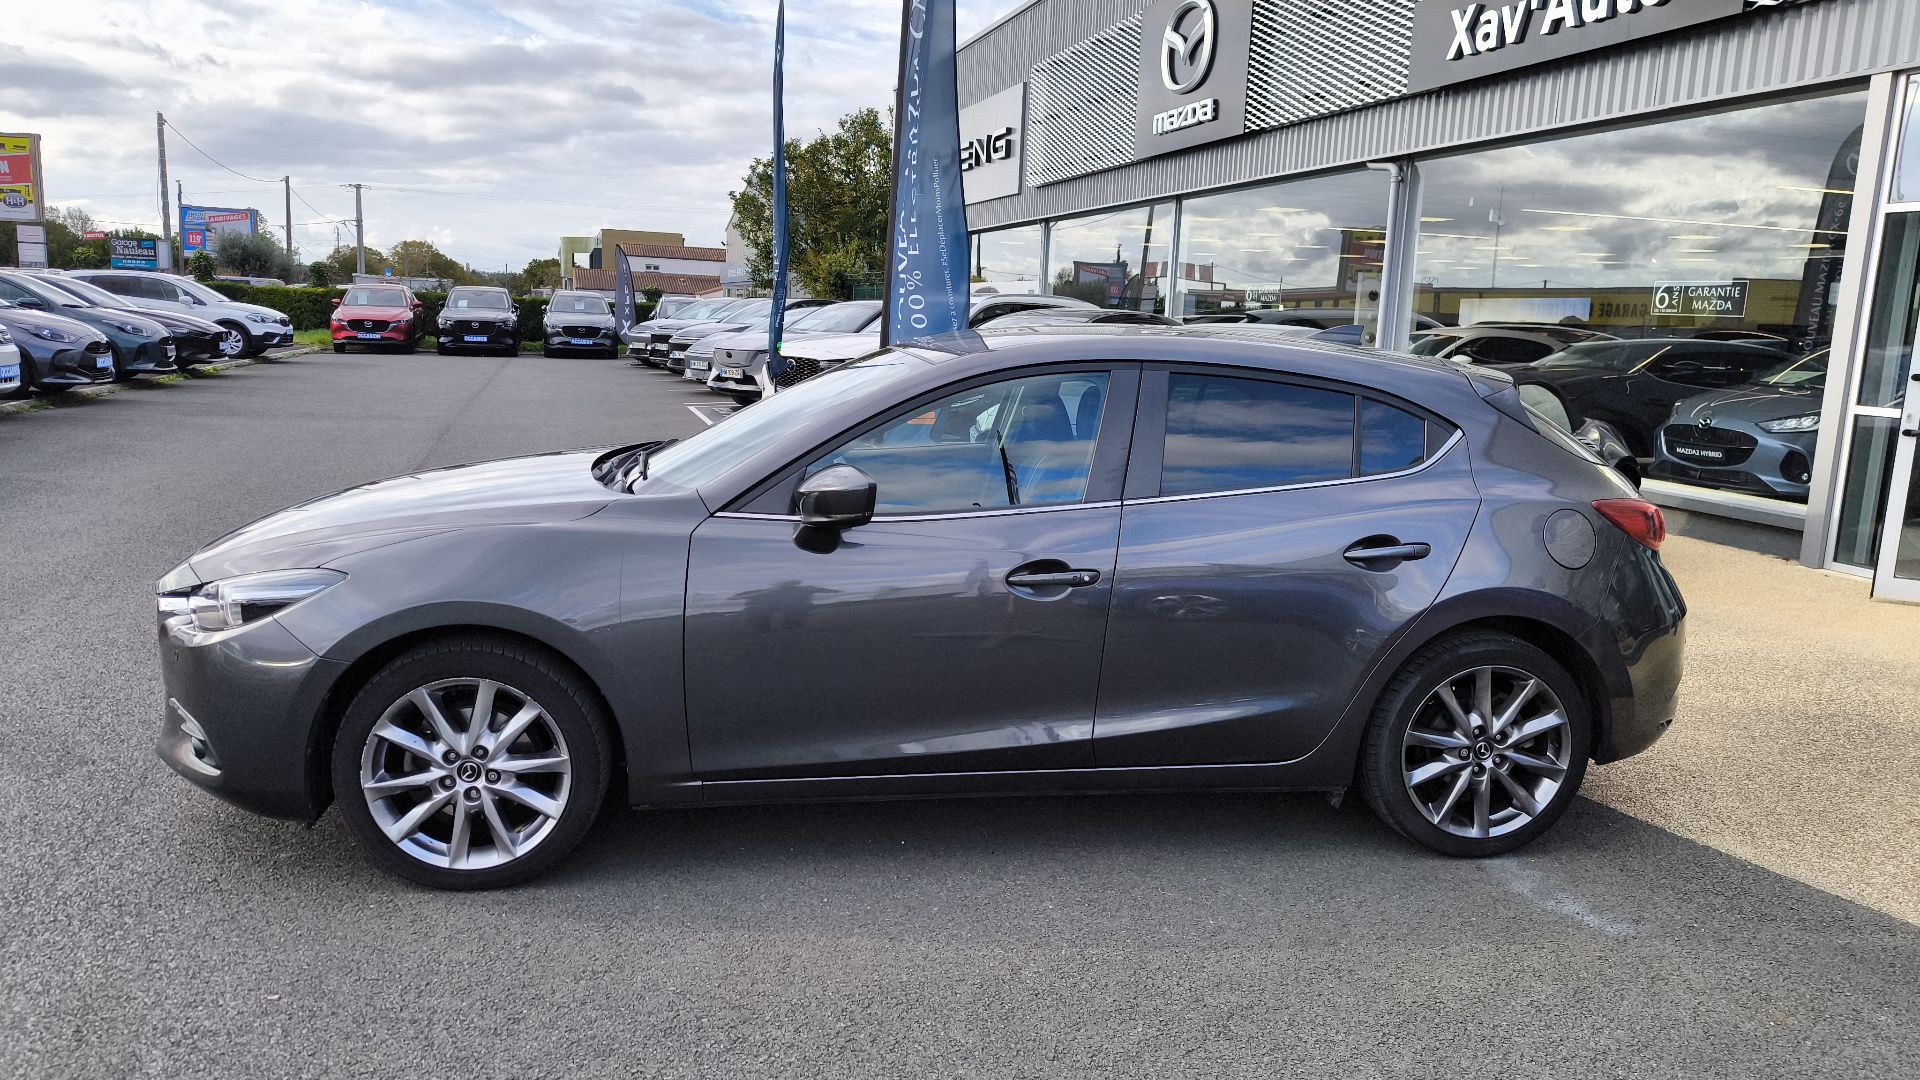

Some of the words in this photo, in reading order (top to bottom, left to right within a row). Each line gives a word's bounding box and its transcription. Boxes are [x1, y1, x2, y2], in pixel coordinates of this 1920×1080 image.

[1446, 0, 1668, 60] Xav'Au
[1153, 98, 1214, 135] mazda
[111, 239, 138, 247] Garage
[116, 245, 155, 256] Nauleau
[1655, 284, 1669, 309] 6
[1671, 286, 1681, 307] ANS
[1688, 286, 1741, 298] GARANTIE
[906, 270, 928, 330] 00%
[1691, 300, 1733, 311] MAZDA
[1700, 450, 1723, 458] HYBRID
